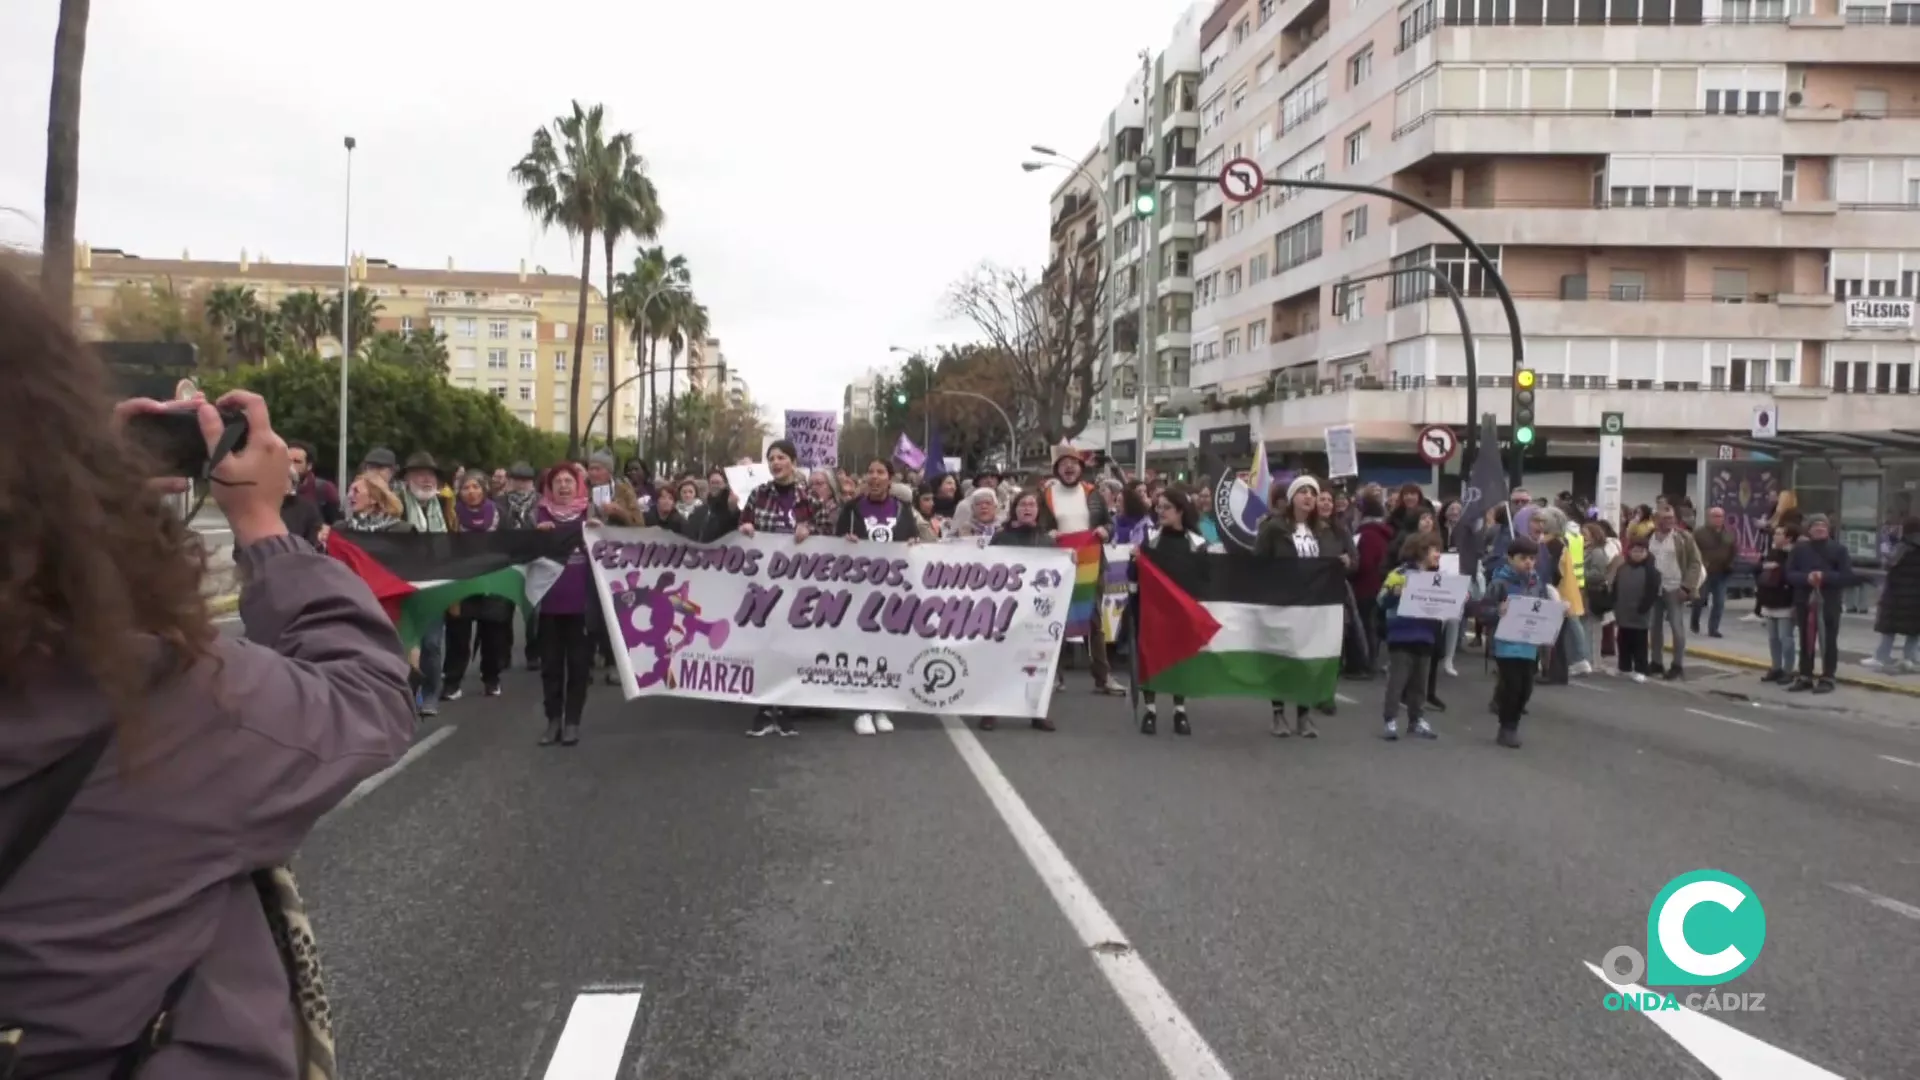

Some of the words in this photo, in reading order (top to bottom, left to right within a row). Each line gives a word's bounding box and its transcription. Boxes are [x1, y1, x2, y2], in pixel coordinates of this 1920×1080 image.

[592, 539, 763, 576] FEMINISMOS
[766, 550, 914, 592] DIVERSOS,
[921, 560, 1027, 592] UNIDOS
[787, 585, 853, 630] EN
[856, 589, 1019, 642] LUCHA!
[680, 659, 754, 694] MARZO
